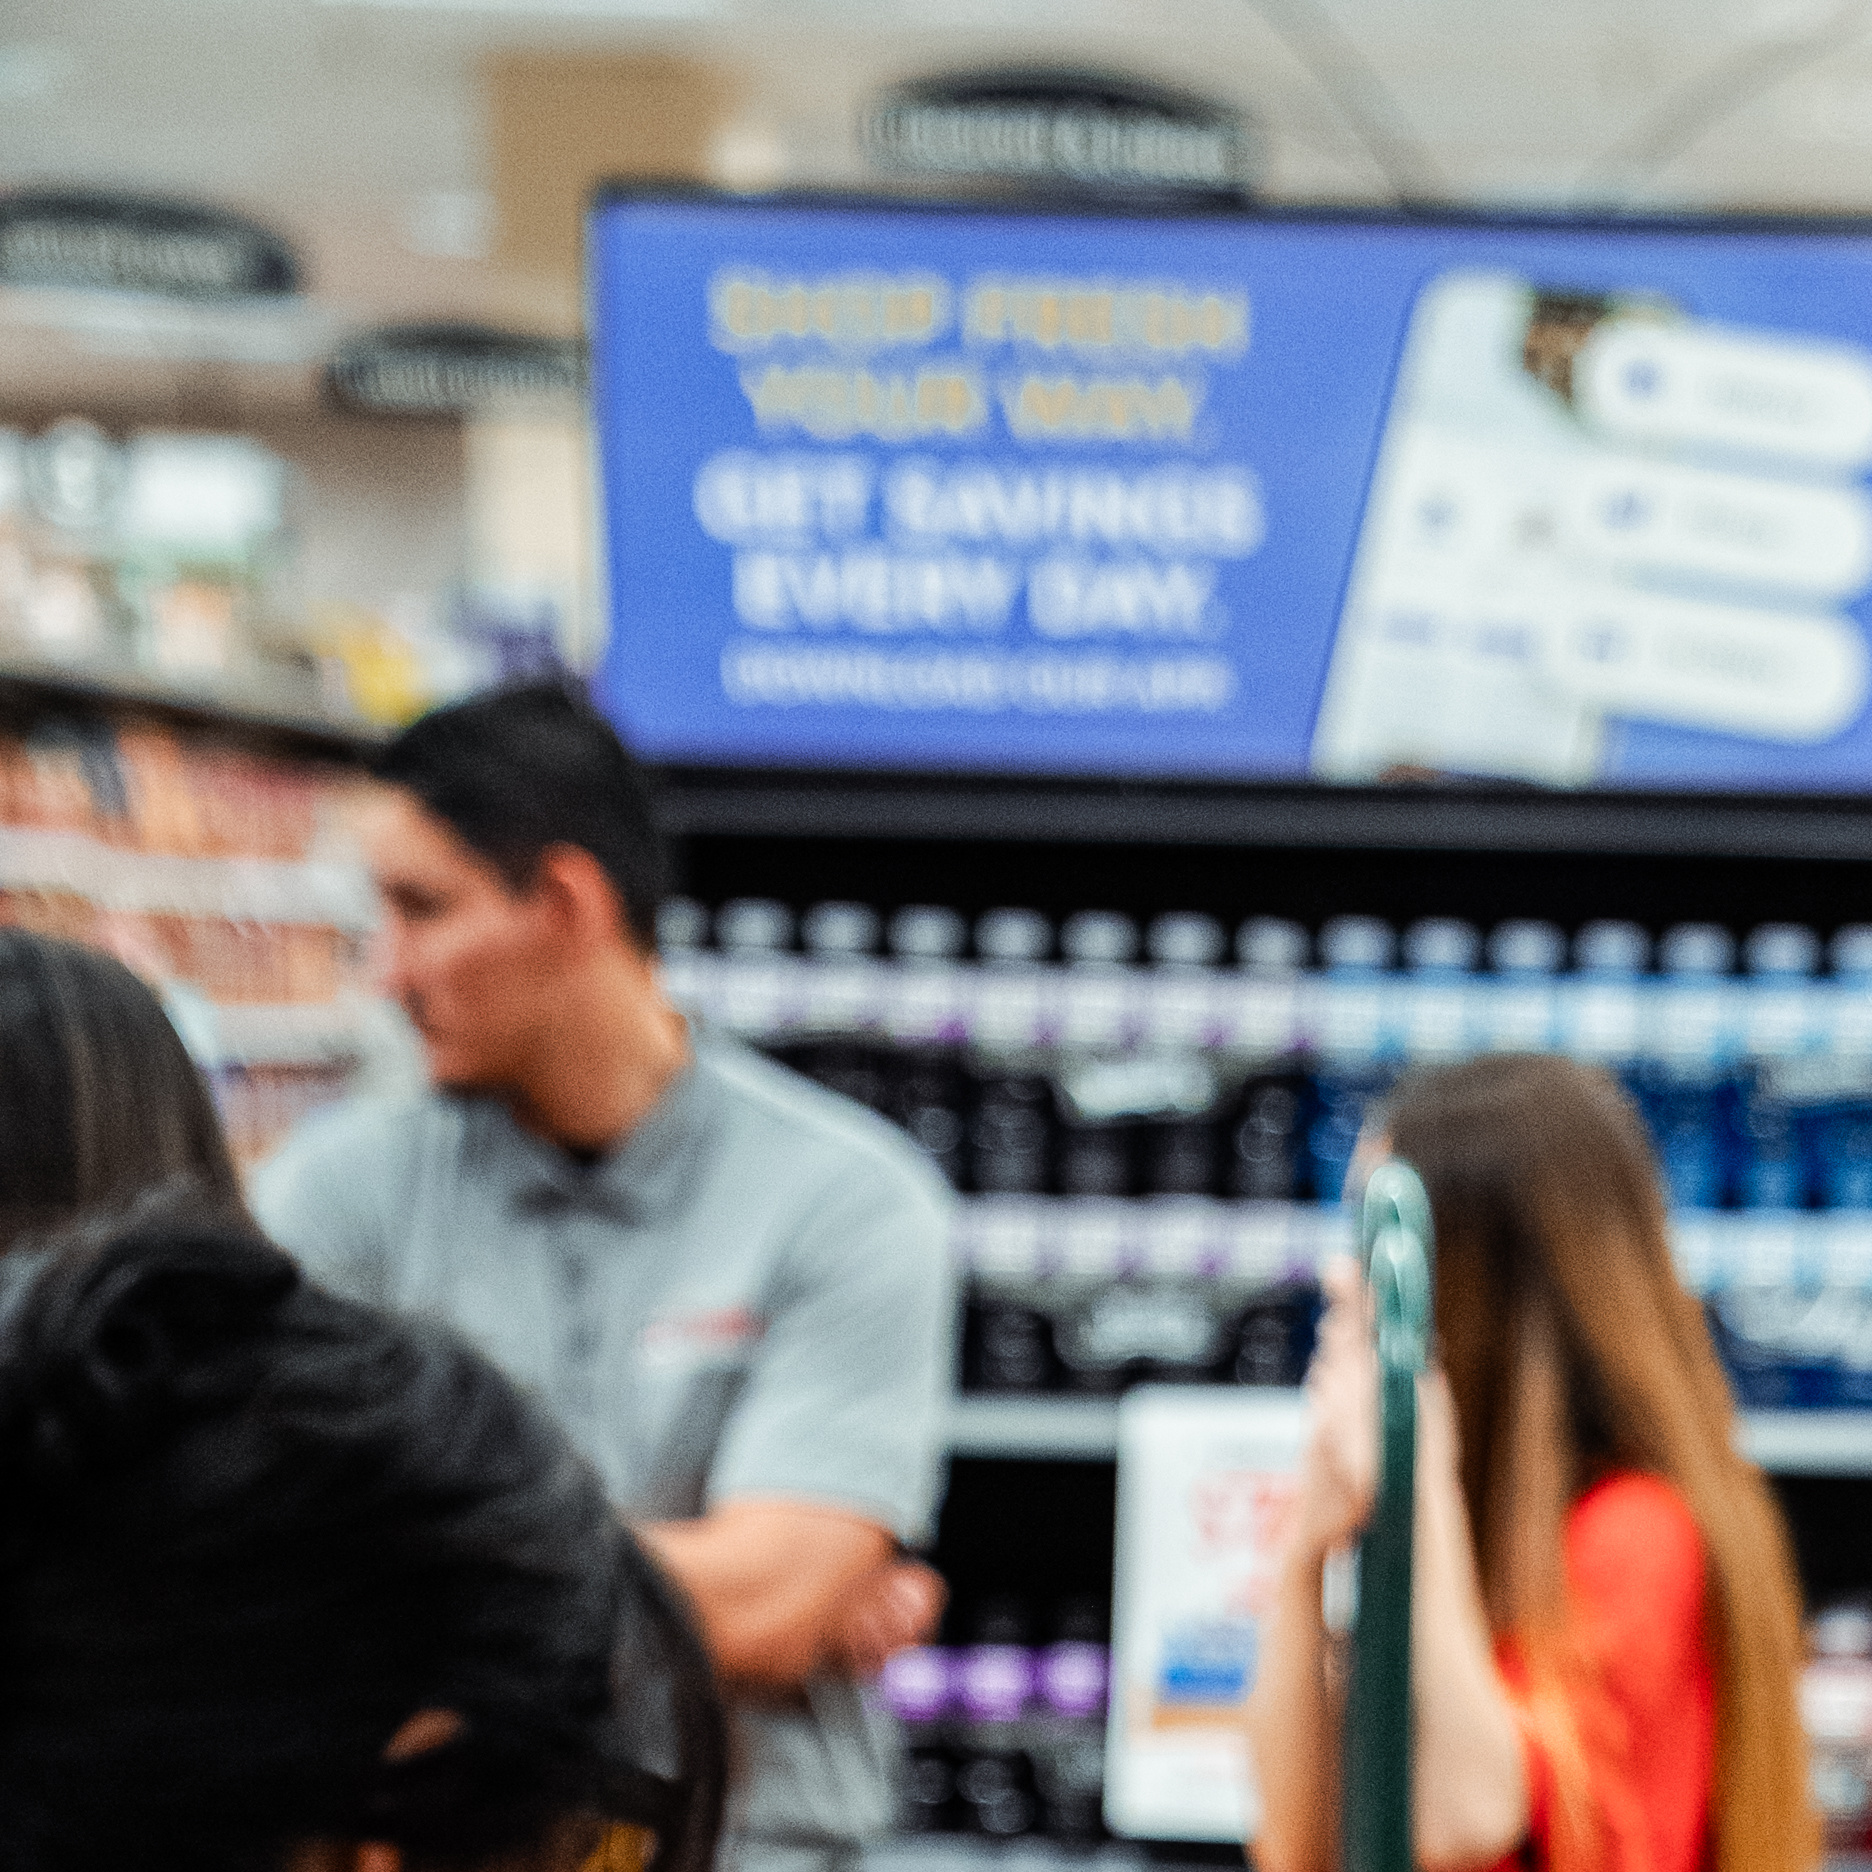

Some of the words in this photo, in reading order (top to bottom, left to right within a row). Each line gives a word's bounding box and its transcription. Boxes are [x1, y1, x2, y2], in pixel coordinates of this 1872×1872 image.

[698, 457, 867, 545] GET
[886, 462, 1260, 556] SAVINGS
[735, 550, 1018, 636] EVERY
